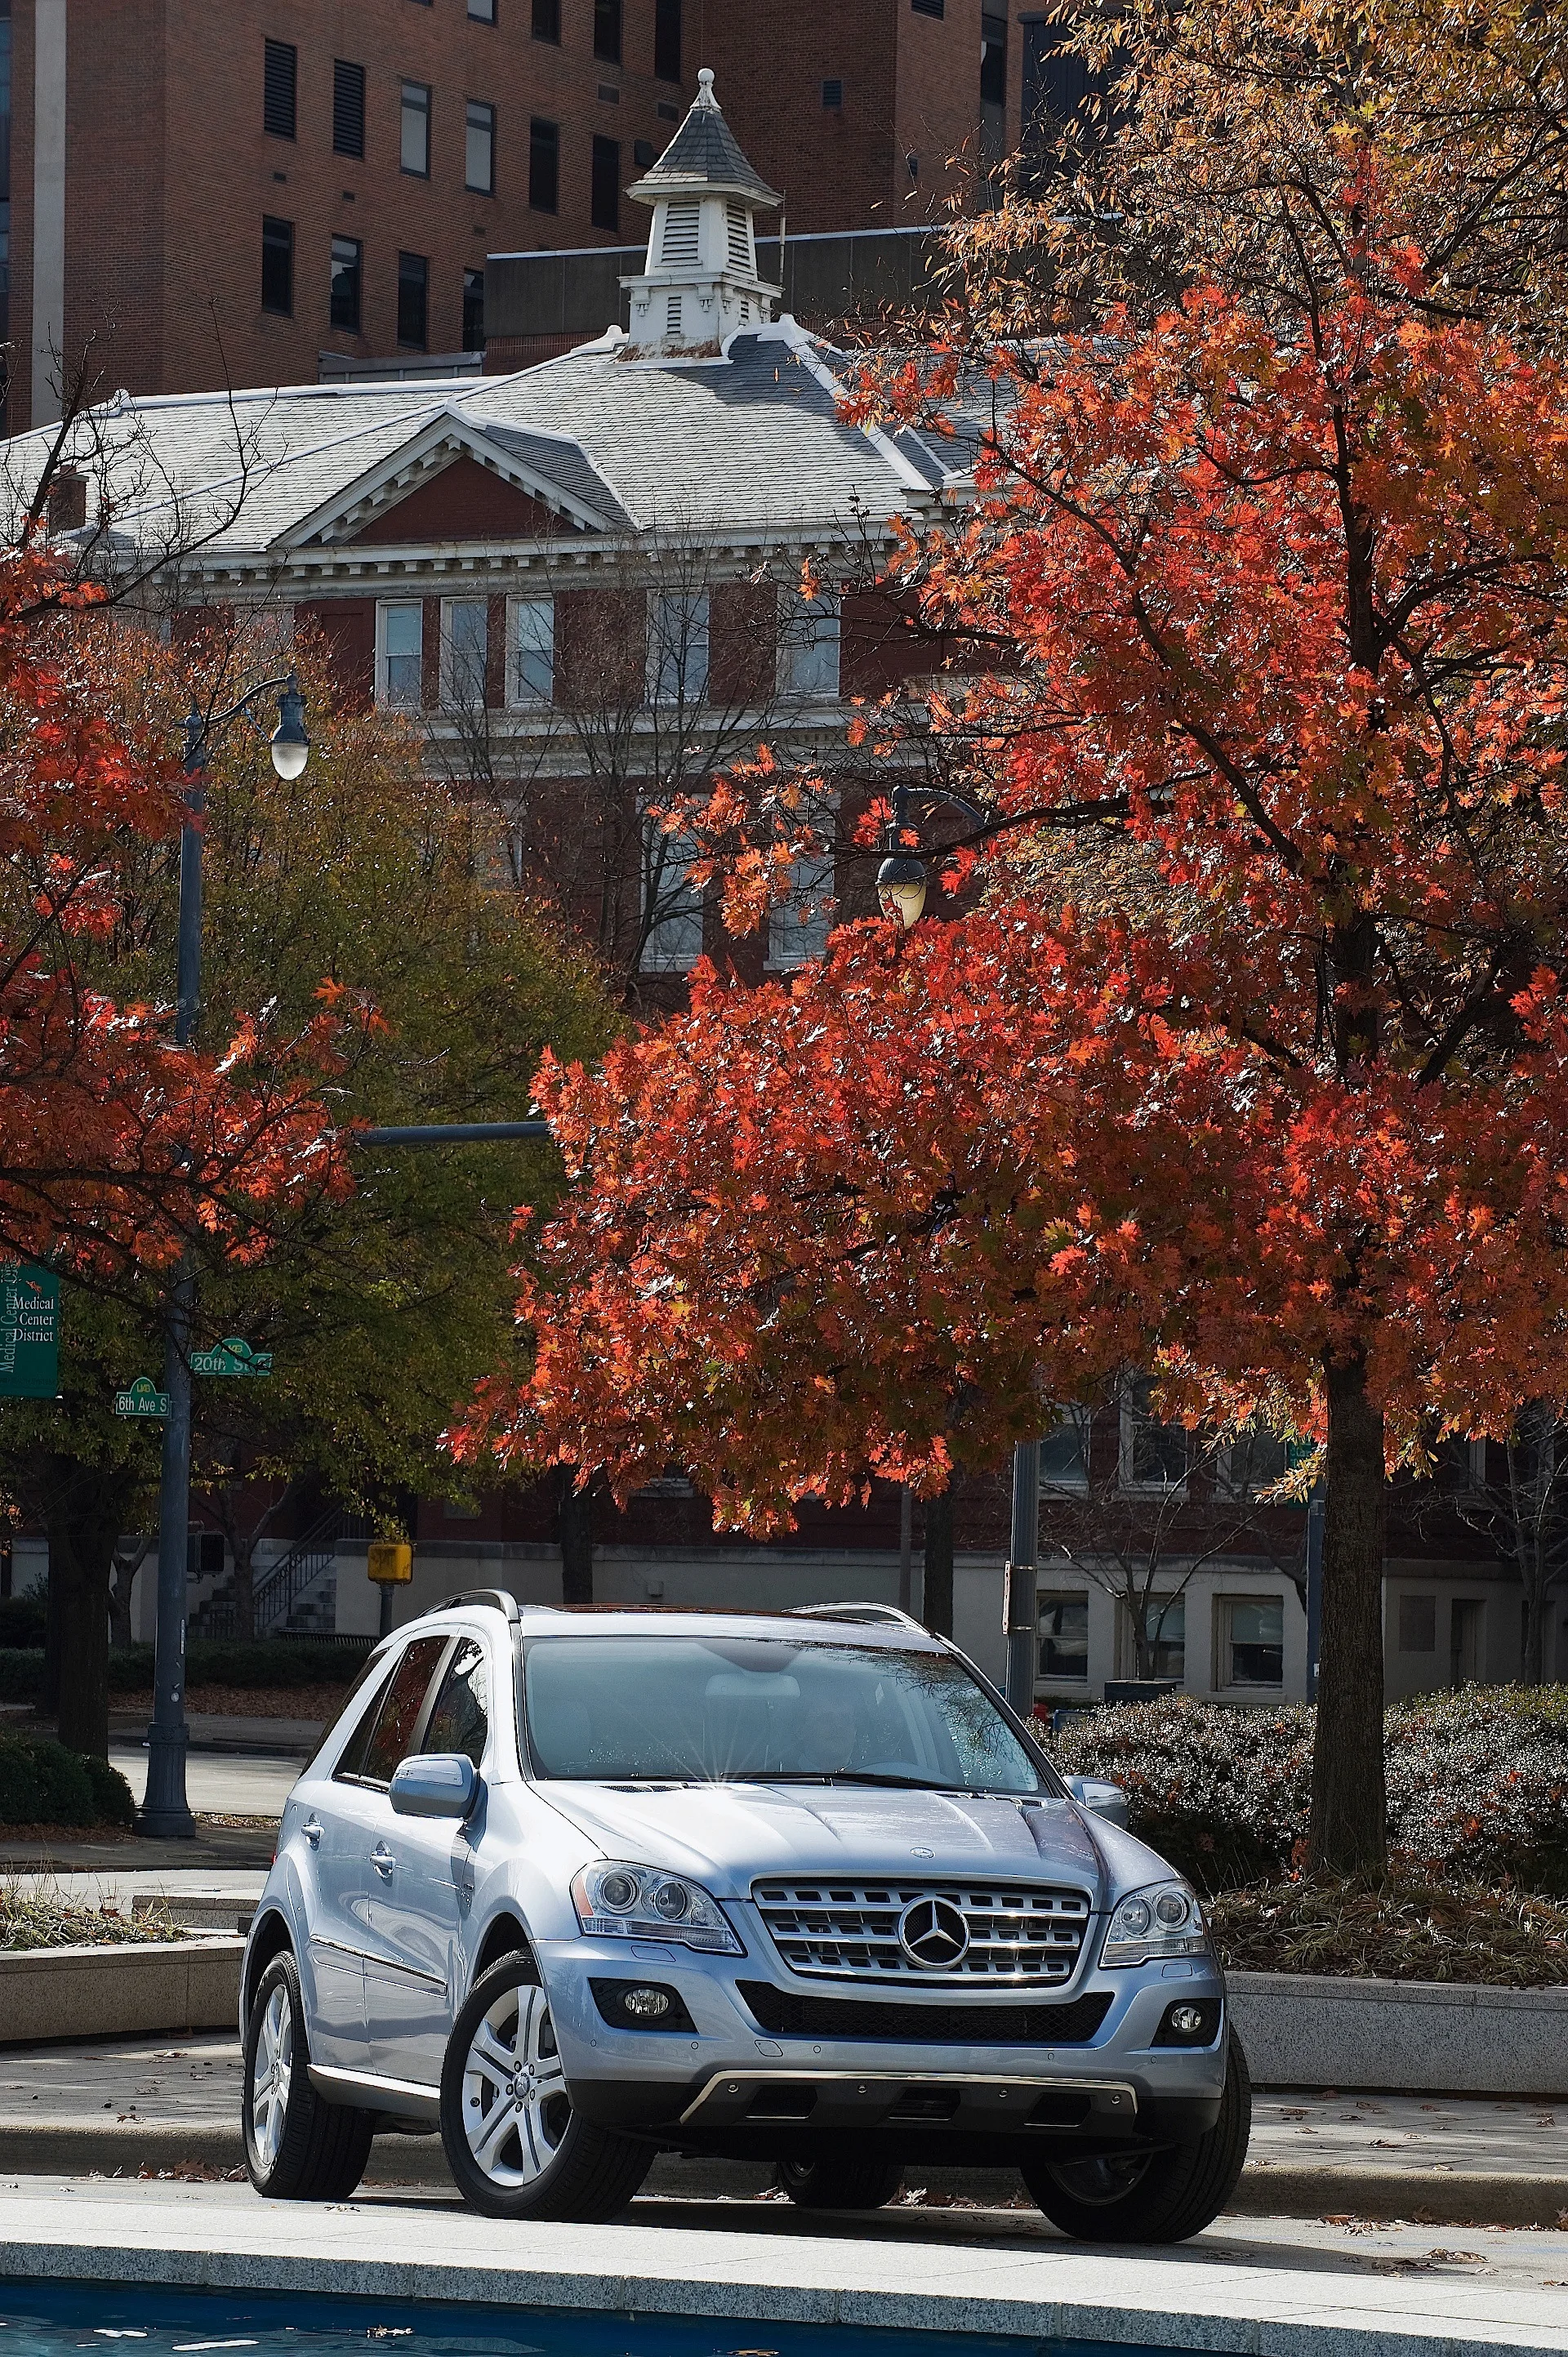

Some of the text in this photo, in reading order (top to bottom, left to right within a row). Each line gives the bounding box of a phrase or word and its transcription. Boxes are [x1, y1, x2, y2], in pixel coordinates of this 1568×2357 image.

[0, 1286, 18, 1325] Center
[12, 1296, 55, 1310] Medical
[19, 1312, 55, 1326] Center
[12, 1328, 55, 1342] District
[0, 1328, 16, 1374] Medical
[194, 1356, 226, 1371] 20th
[136, 1383, 151, 1392] UAB
[118, 1396, 167, 1413] 6th Ave S
